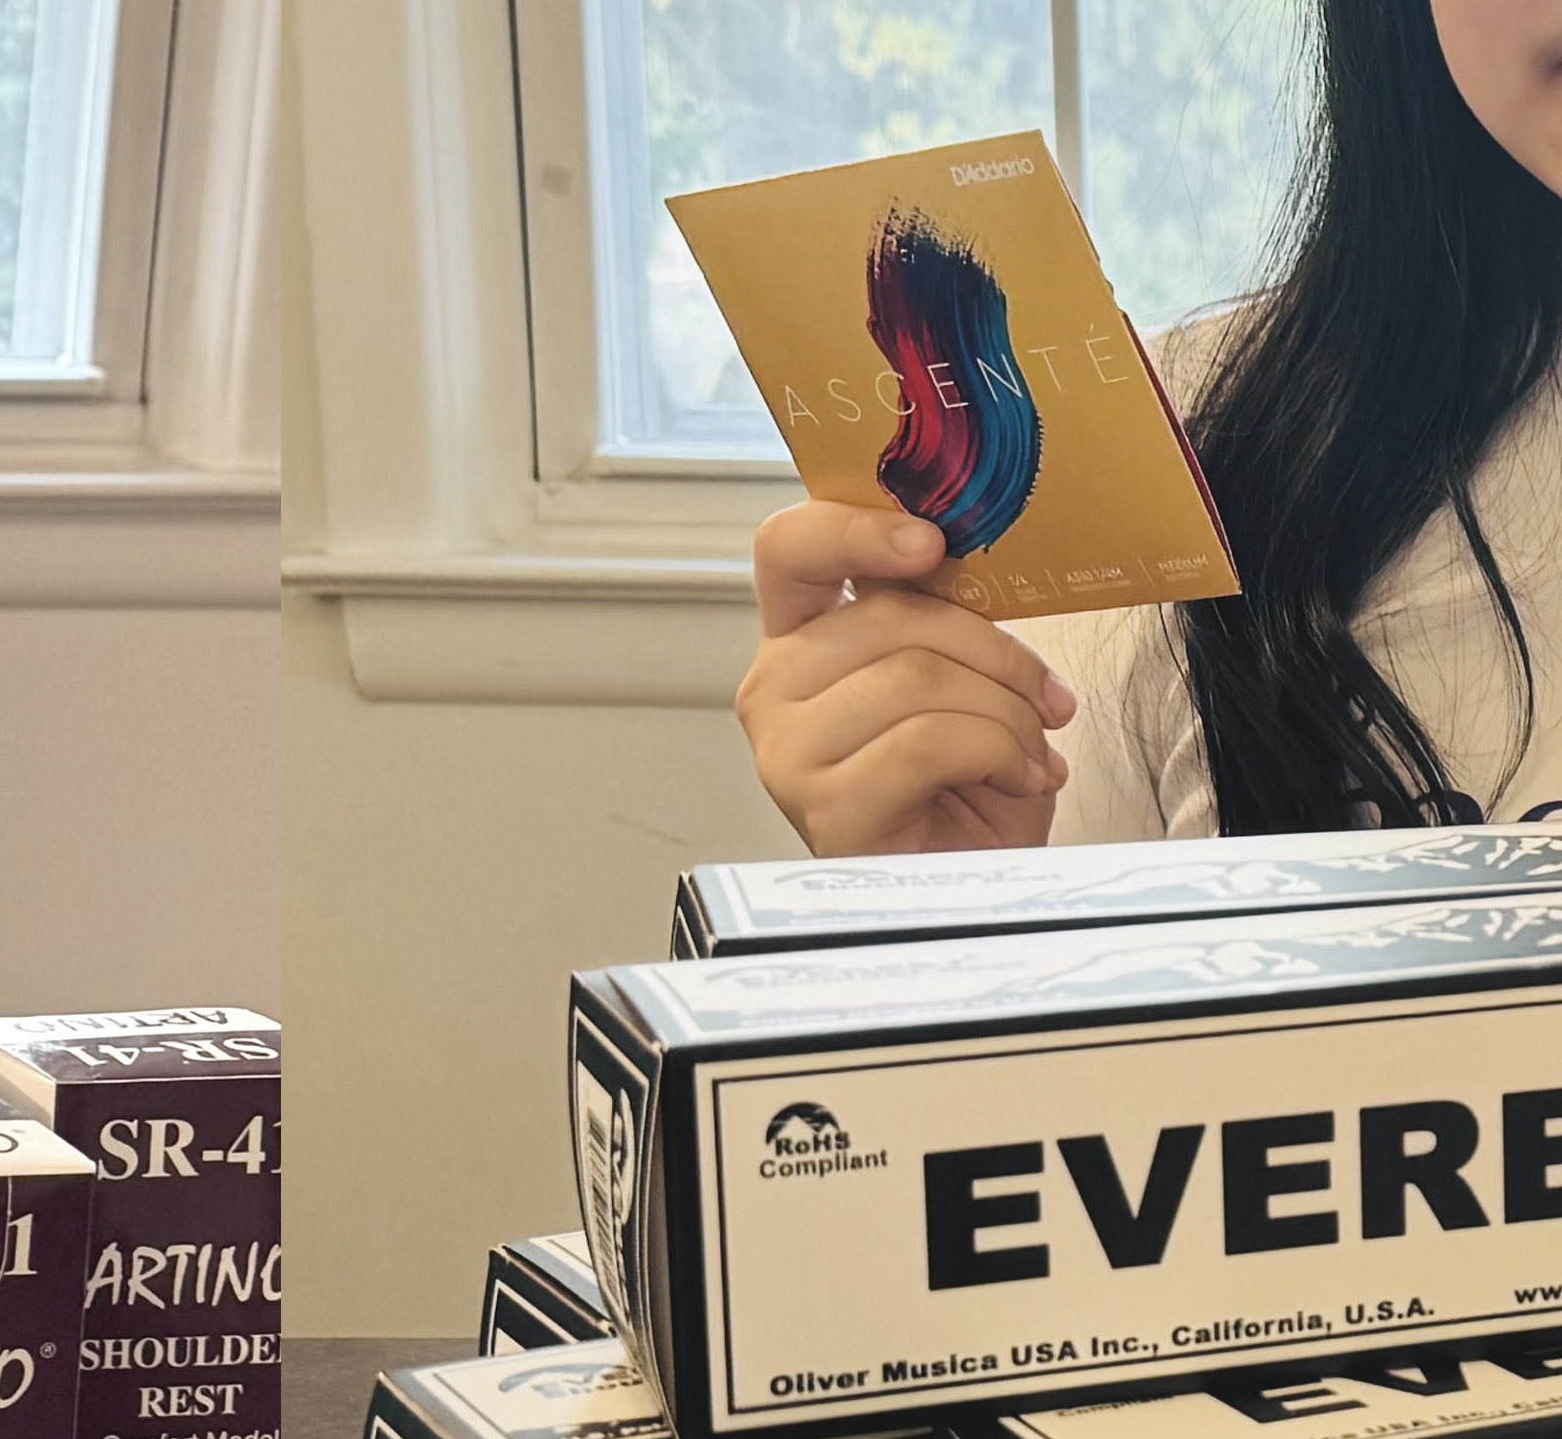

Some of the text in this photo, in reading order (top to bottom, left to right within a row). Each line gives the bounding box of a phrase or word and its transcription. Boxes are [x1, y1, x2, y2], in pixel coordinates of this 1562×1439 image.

[950, 157, 1036, 188] D'Addario
[773, 1129, 852, 1159] RoHS
[757, 1148, 889, 1181] Compliant
[79, 1335, 280, 1371] SHOULDE
[769, 1295, 1436, 1398] Oliver Musica USA Inc., California, U.S.A.
[137, 1383, 243, 1419] REST
[1365, 1414, 1425, 1439] USA
